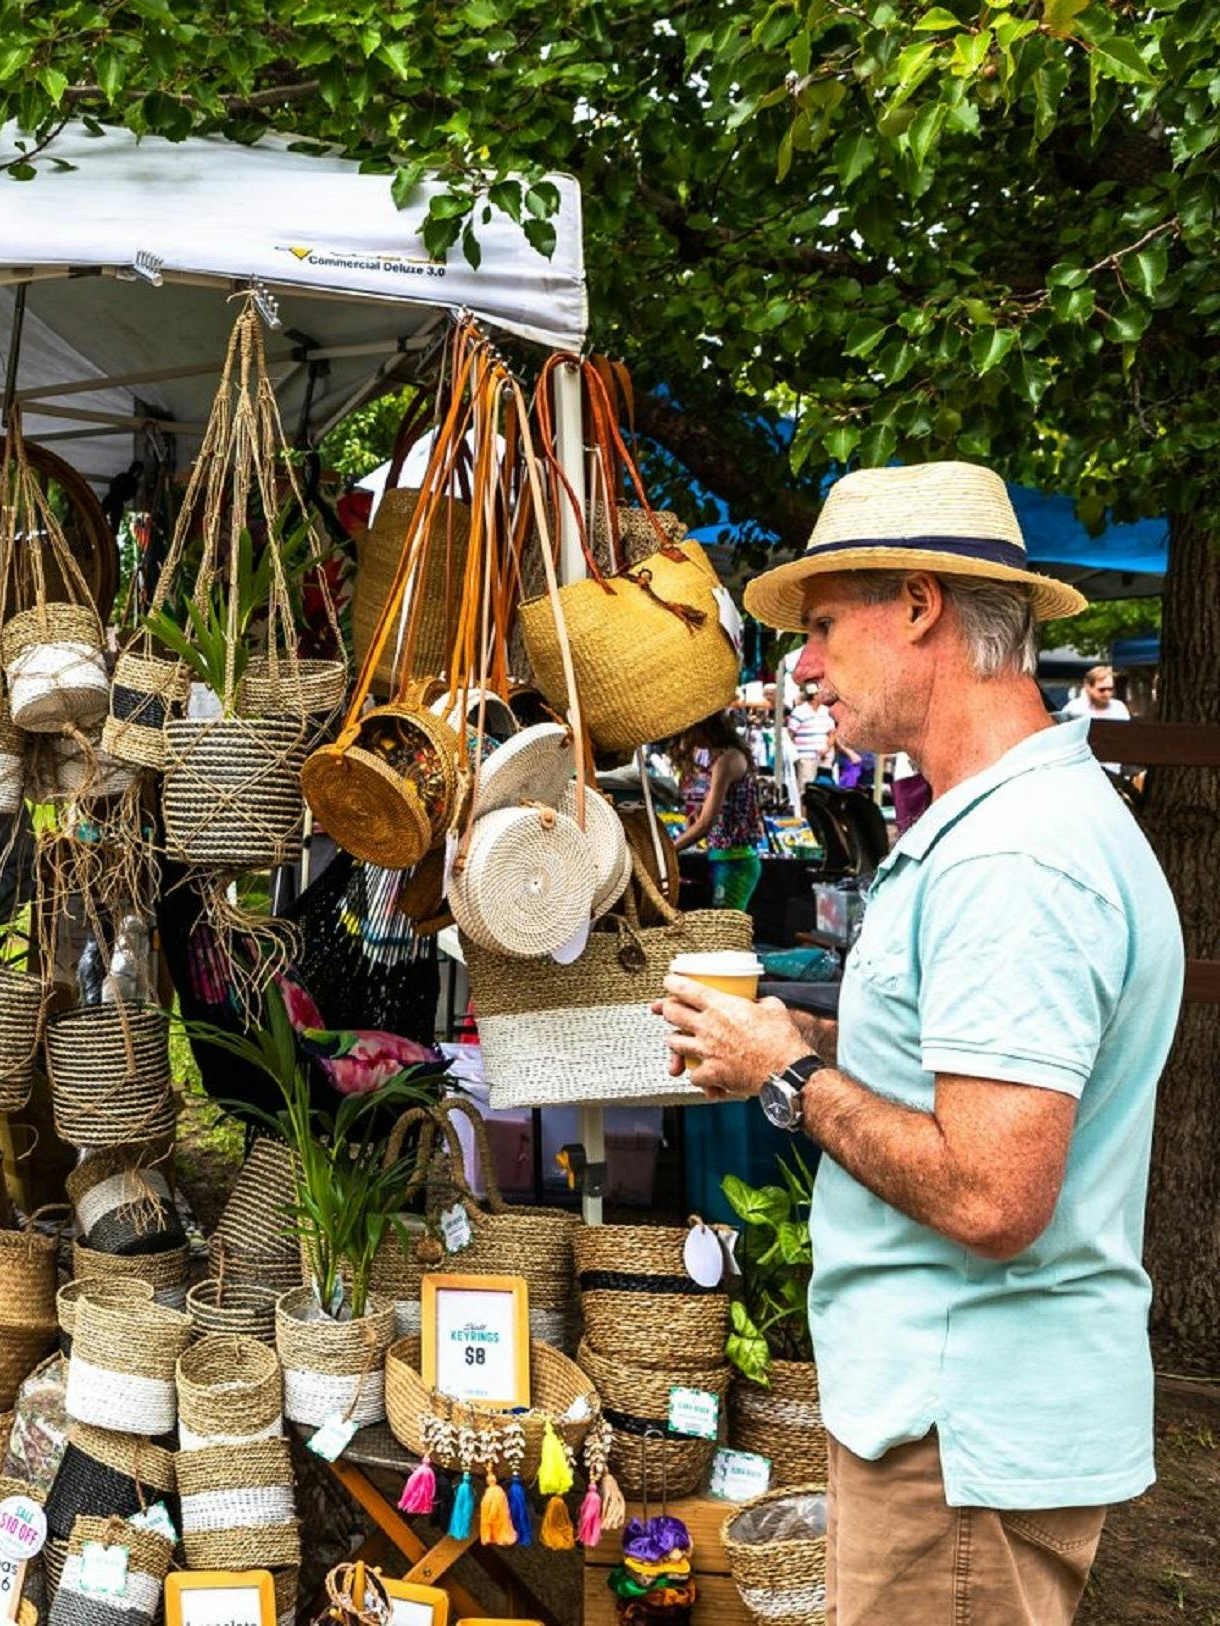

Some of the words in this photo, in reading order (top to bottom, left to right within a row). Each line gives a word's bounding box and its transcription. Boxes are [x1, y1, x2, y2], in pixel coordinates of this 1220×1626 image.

[308, 255, 380, 271] Commercial
[383, 262, 424, 275] Deluxe
[427, 266, 446, 277] 3.0
[450, 1330, 499, 1343] KEYRINGS
[465, 1346, 485, 1365] $8
[15, 1505, 35, 1525] SALE
[0, 1512, 18, 1534] $10
[18, 1524, 39, 1546] OFF
[1, 1576, 11, 1591] 6
